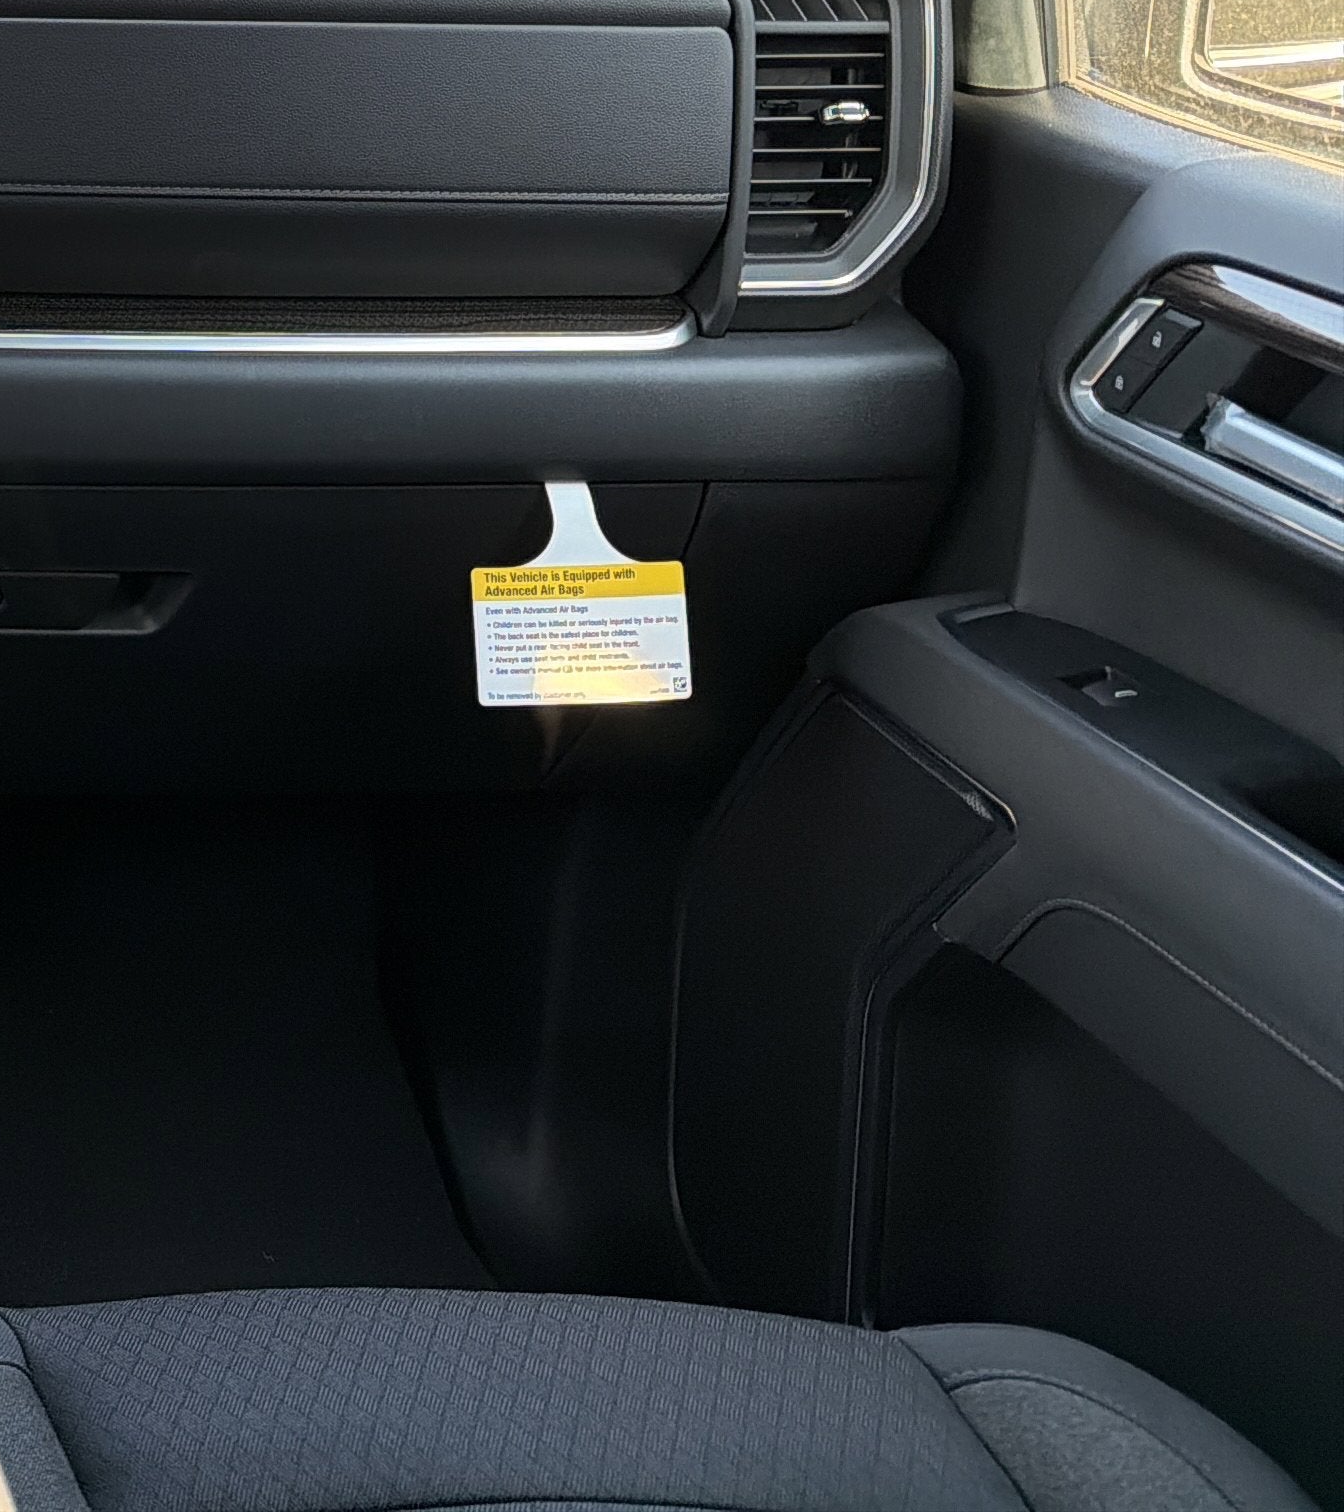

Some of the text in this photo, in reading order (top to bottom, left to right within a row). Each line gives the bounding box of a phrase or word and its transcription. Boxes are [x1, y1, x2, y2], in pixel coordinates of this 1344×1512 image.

[484, 569, 635, 583] This Vehicle is Equipped with
[485, 584, 584, 596] Advanced Air Bags
[571, 605, 588, 614] Bags
